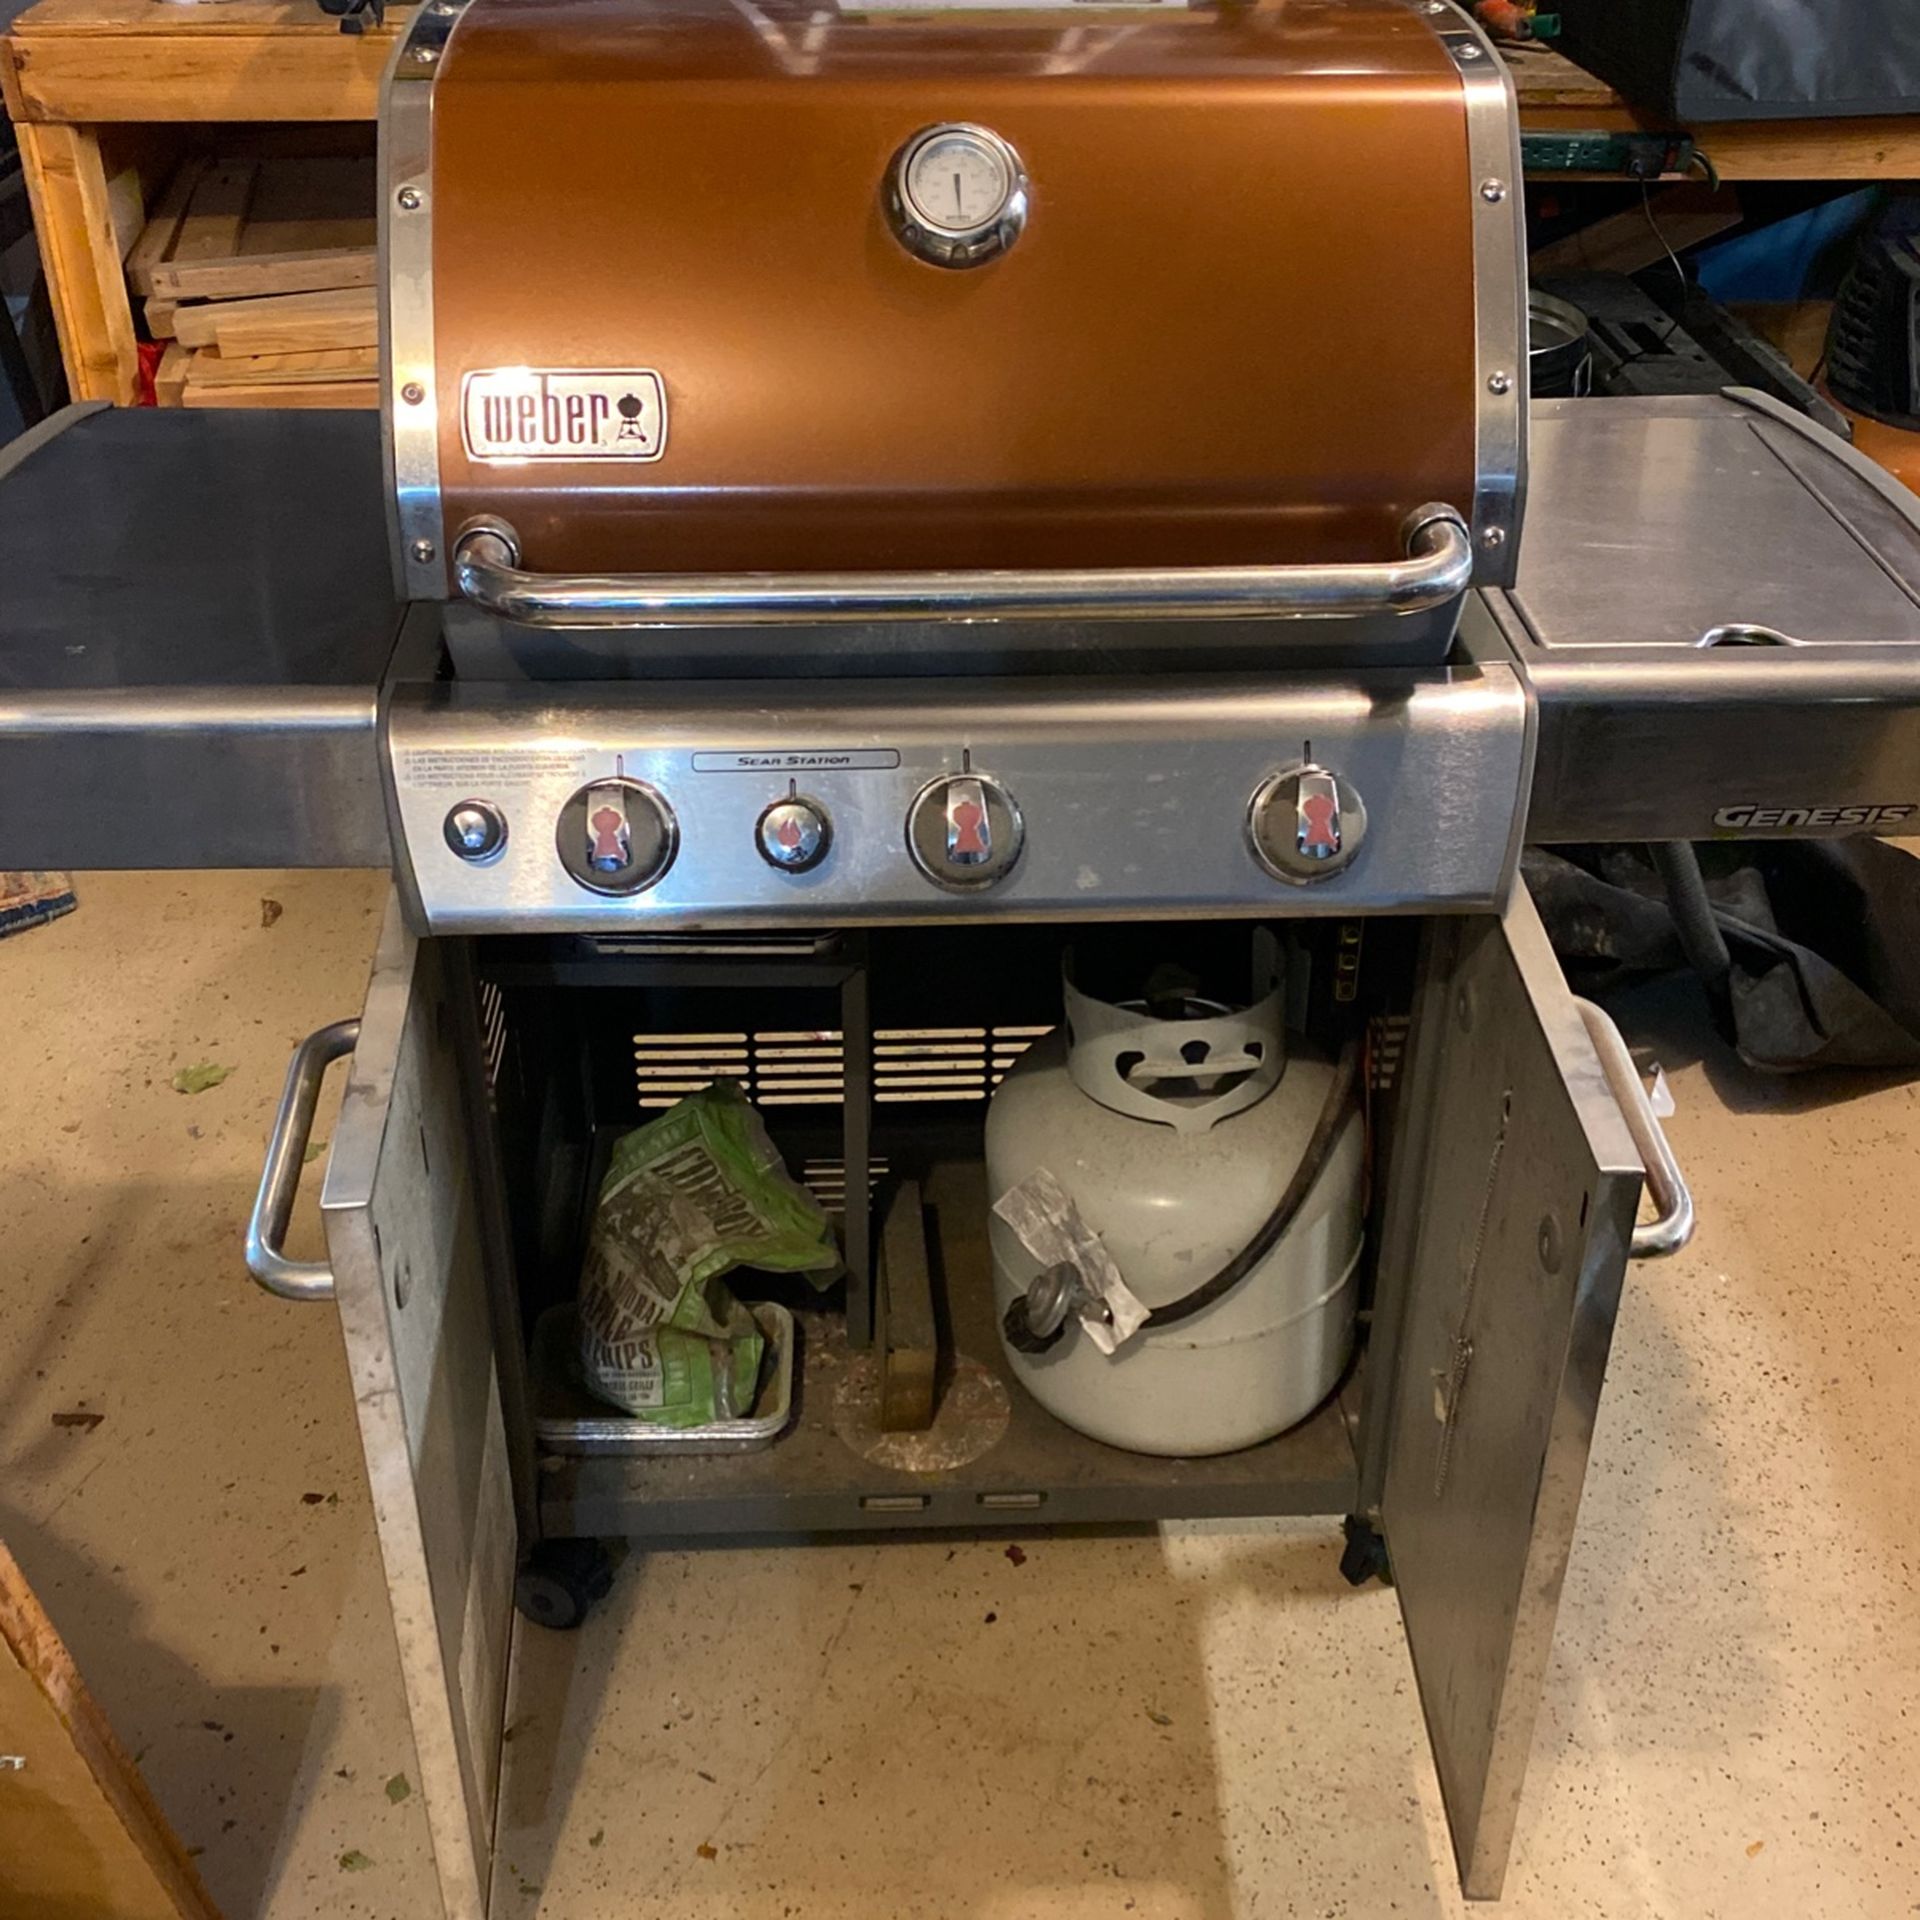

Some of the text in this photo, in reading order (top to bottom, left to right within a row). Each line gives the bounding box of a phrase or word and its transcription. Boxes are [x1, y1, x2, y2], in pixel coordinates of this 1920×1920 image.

[481, 376, 609, 444] weber
[785, 755, 850, 765] STATION
[1713, 804, 1917, 828] GENESIS
